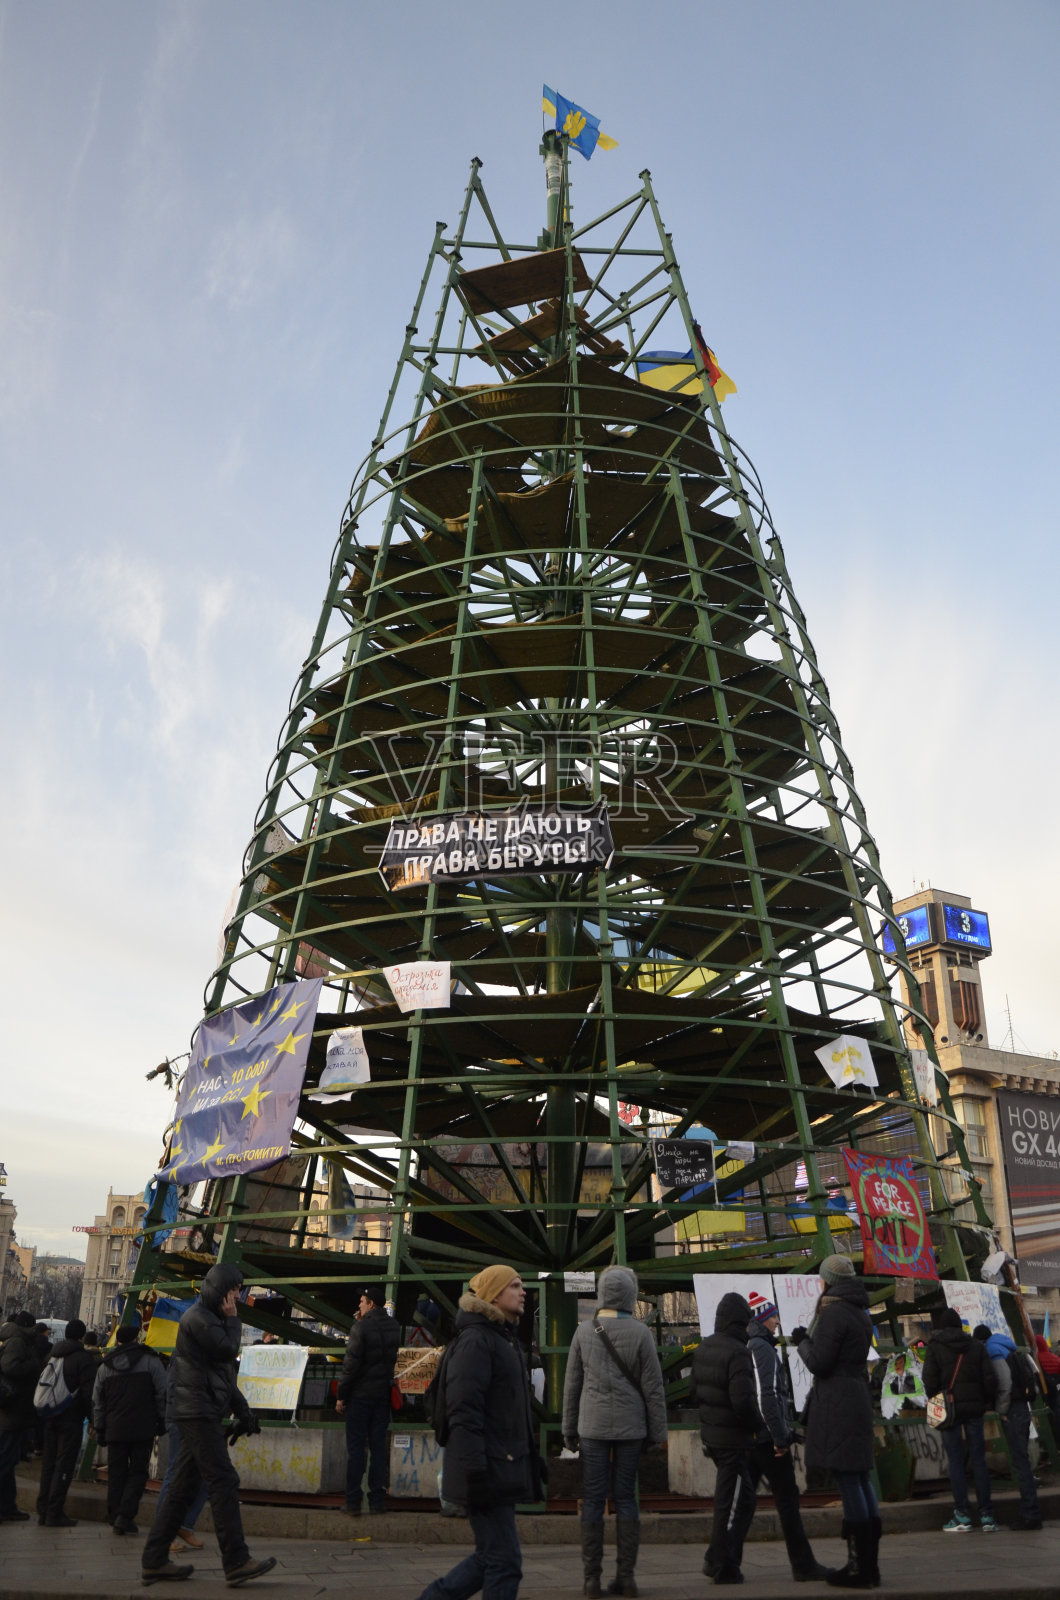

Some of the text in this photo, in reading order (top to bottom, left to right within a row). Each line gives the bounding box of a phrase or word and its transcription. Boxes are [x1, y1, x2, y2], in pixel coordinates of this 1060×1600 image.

[387, 812, 592, 850] ПРАВА НЕ ДАЮТЬ
[403, 840, 588, 880] ПРАВА БЕРУТЬ!
[960, 912, 971, 933] 3
[197, 1075, 222, 1094] НАС
[231, 1068, 245, 1086] 10
[244, 1058, 270, 1081] 000!
[225, 1145, 284, 1165] ПУСТОМИТИ
[1012, 1130, 1042, 1156] GX
[842, 1147, 916, 1180] WE CAME
[874, 1181, 901, 1200] FOR
[872, 1196, 916, 1218] PEACE
[254, 1351, 296, 1368] СЛАВА
[243, 1380, 297, 1407] УКРАЇНІ
